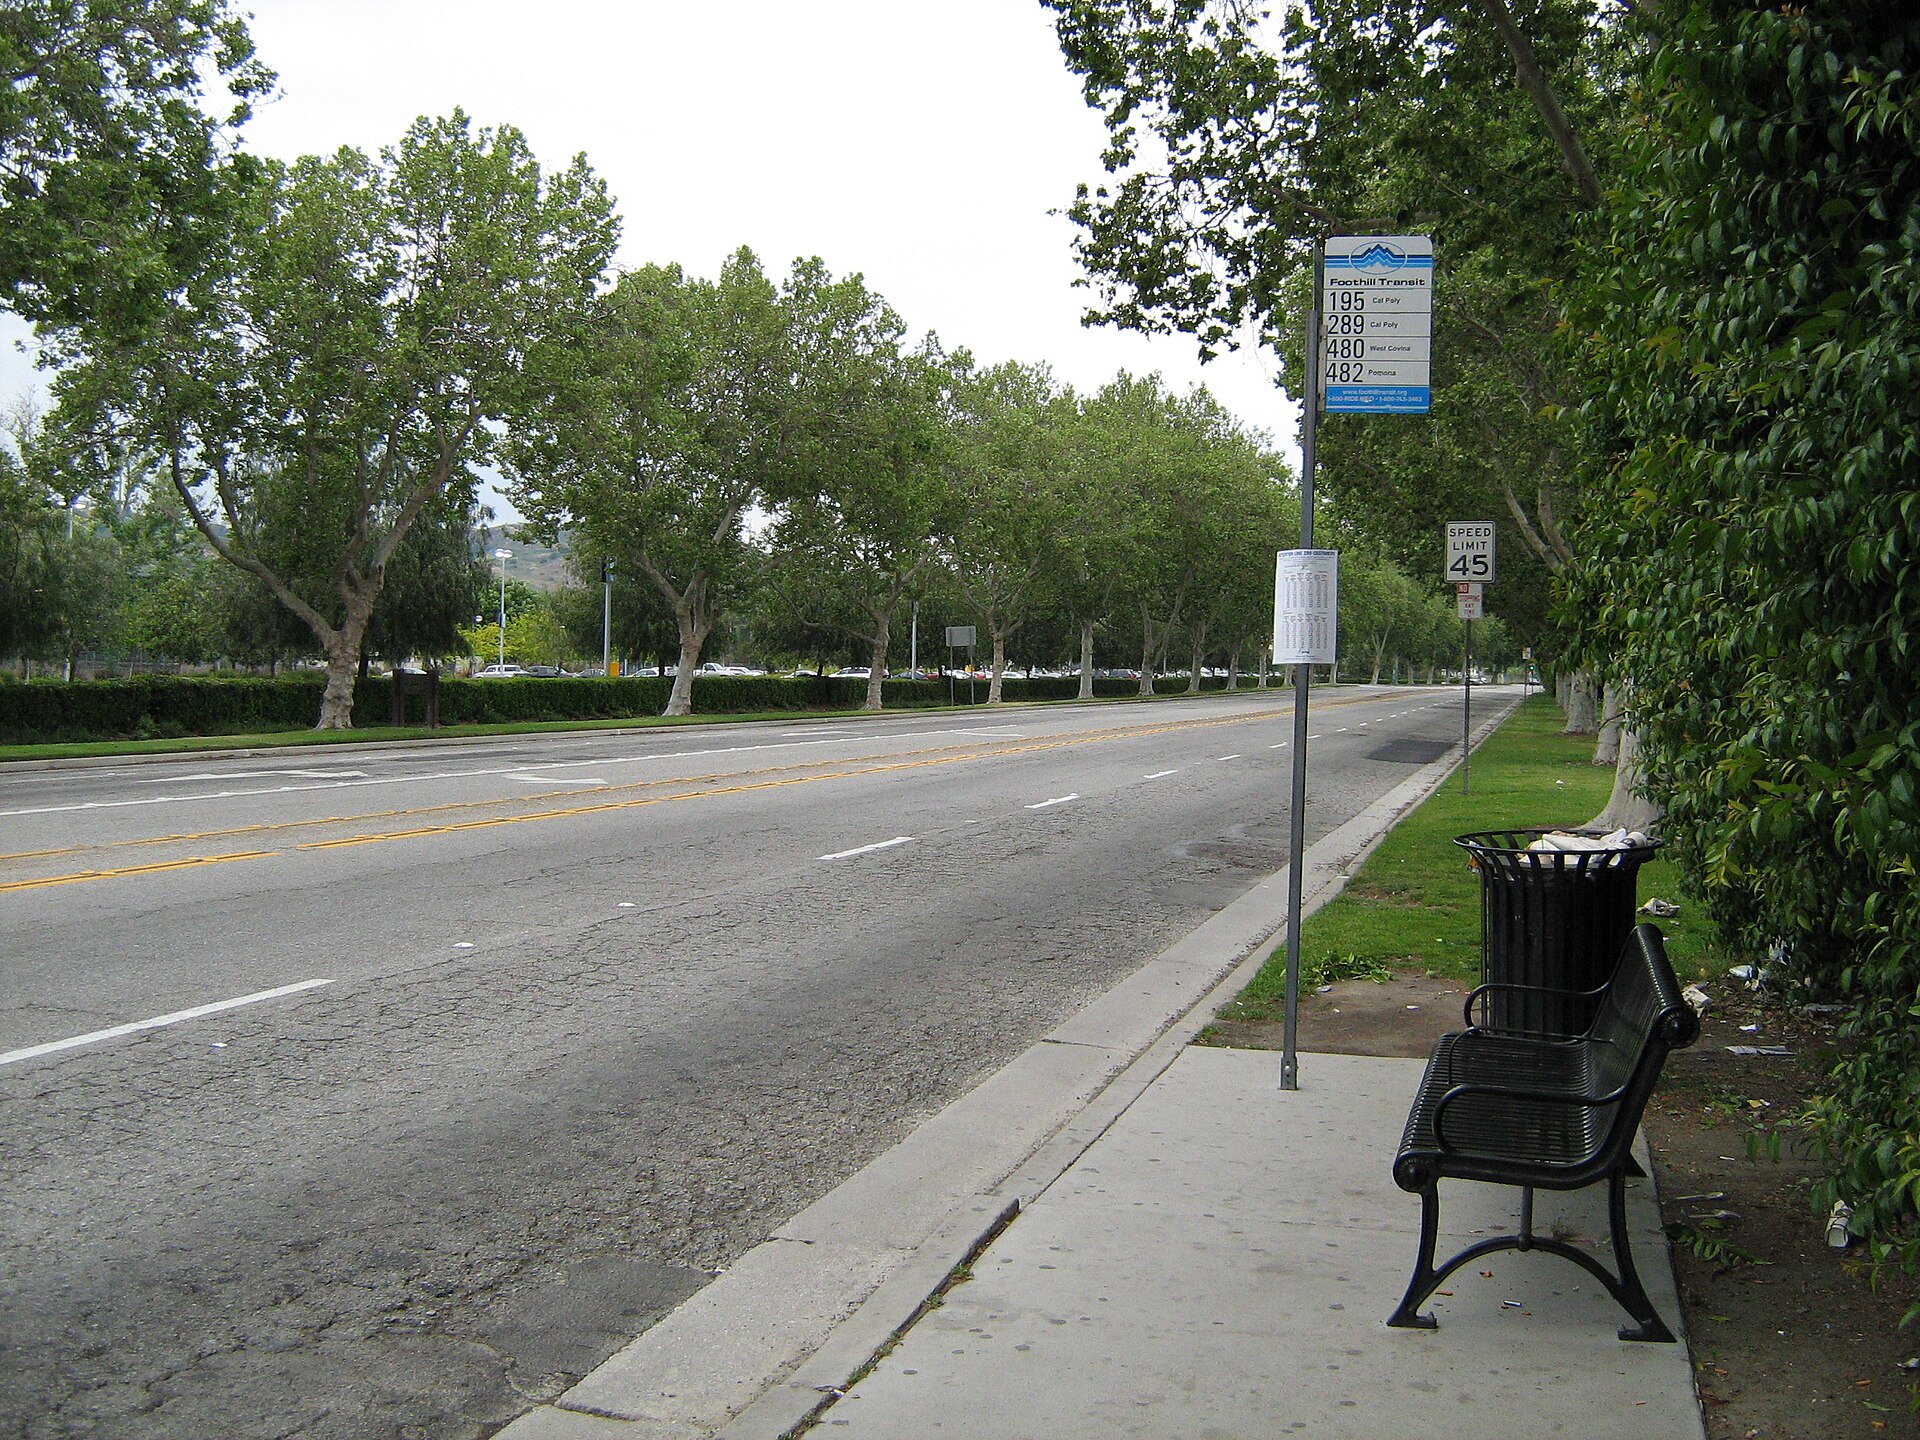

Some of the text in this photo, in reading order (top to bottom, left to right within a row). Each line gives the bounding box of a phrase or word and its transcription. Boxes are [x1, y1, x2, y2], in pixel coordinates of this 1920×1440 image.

[1330, 278, 1426, 286] Foothill Transit
[1329, 291, 1365, 311] 195
[1385, 297, 1401, 305] Poly
[1327, 315, 1365, 335] 289
[1383, 321, 1399, 330] Poly
[1326, 338, 1365, 359] 480
[1325, 362, 1363, 383] 482
[1449, 528, 1491, 537] SPEED
[1453, 541, 1487, 551] LIMIT
[1449, 554, 1489, 576] 45
